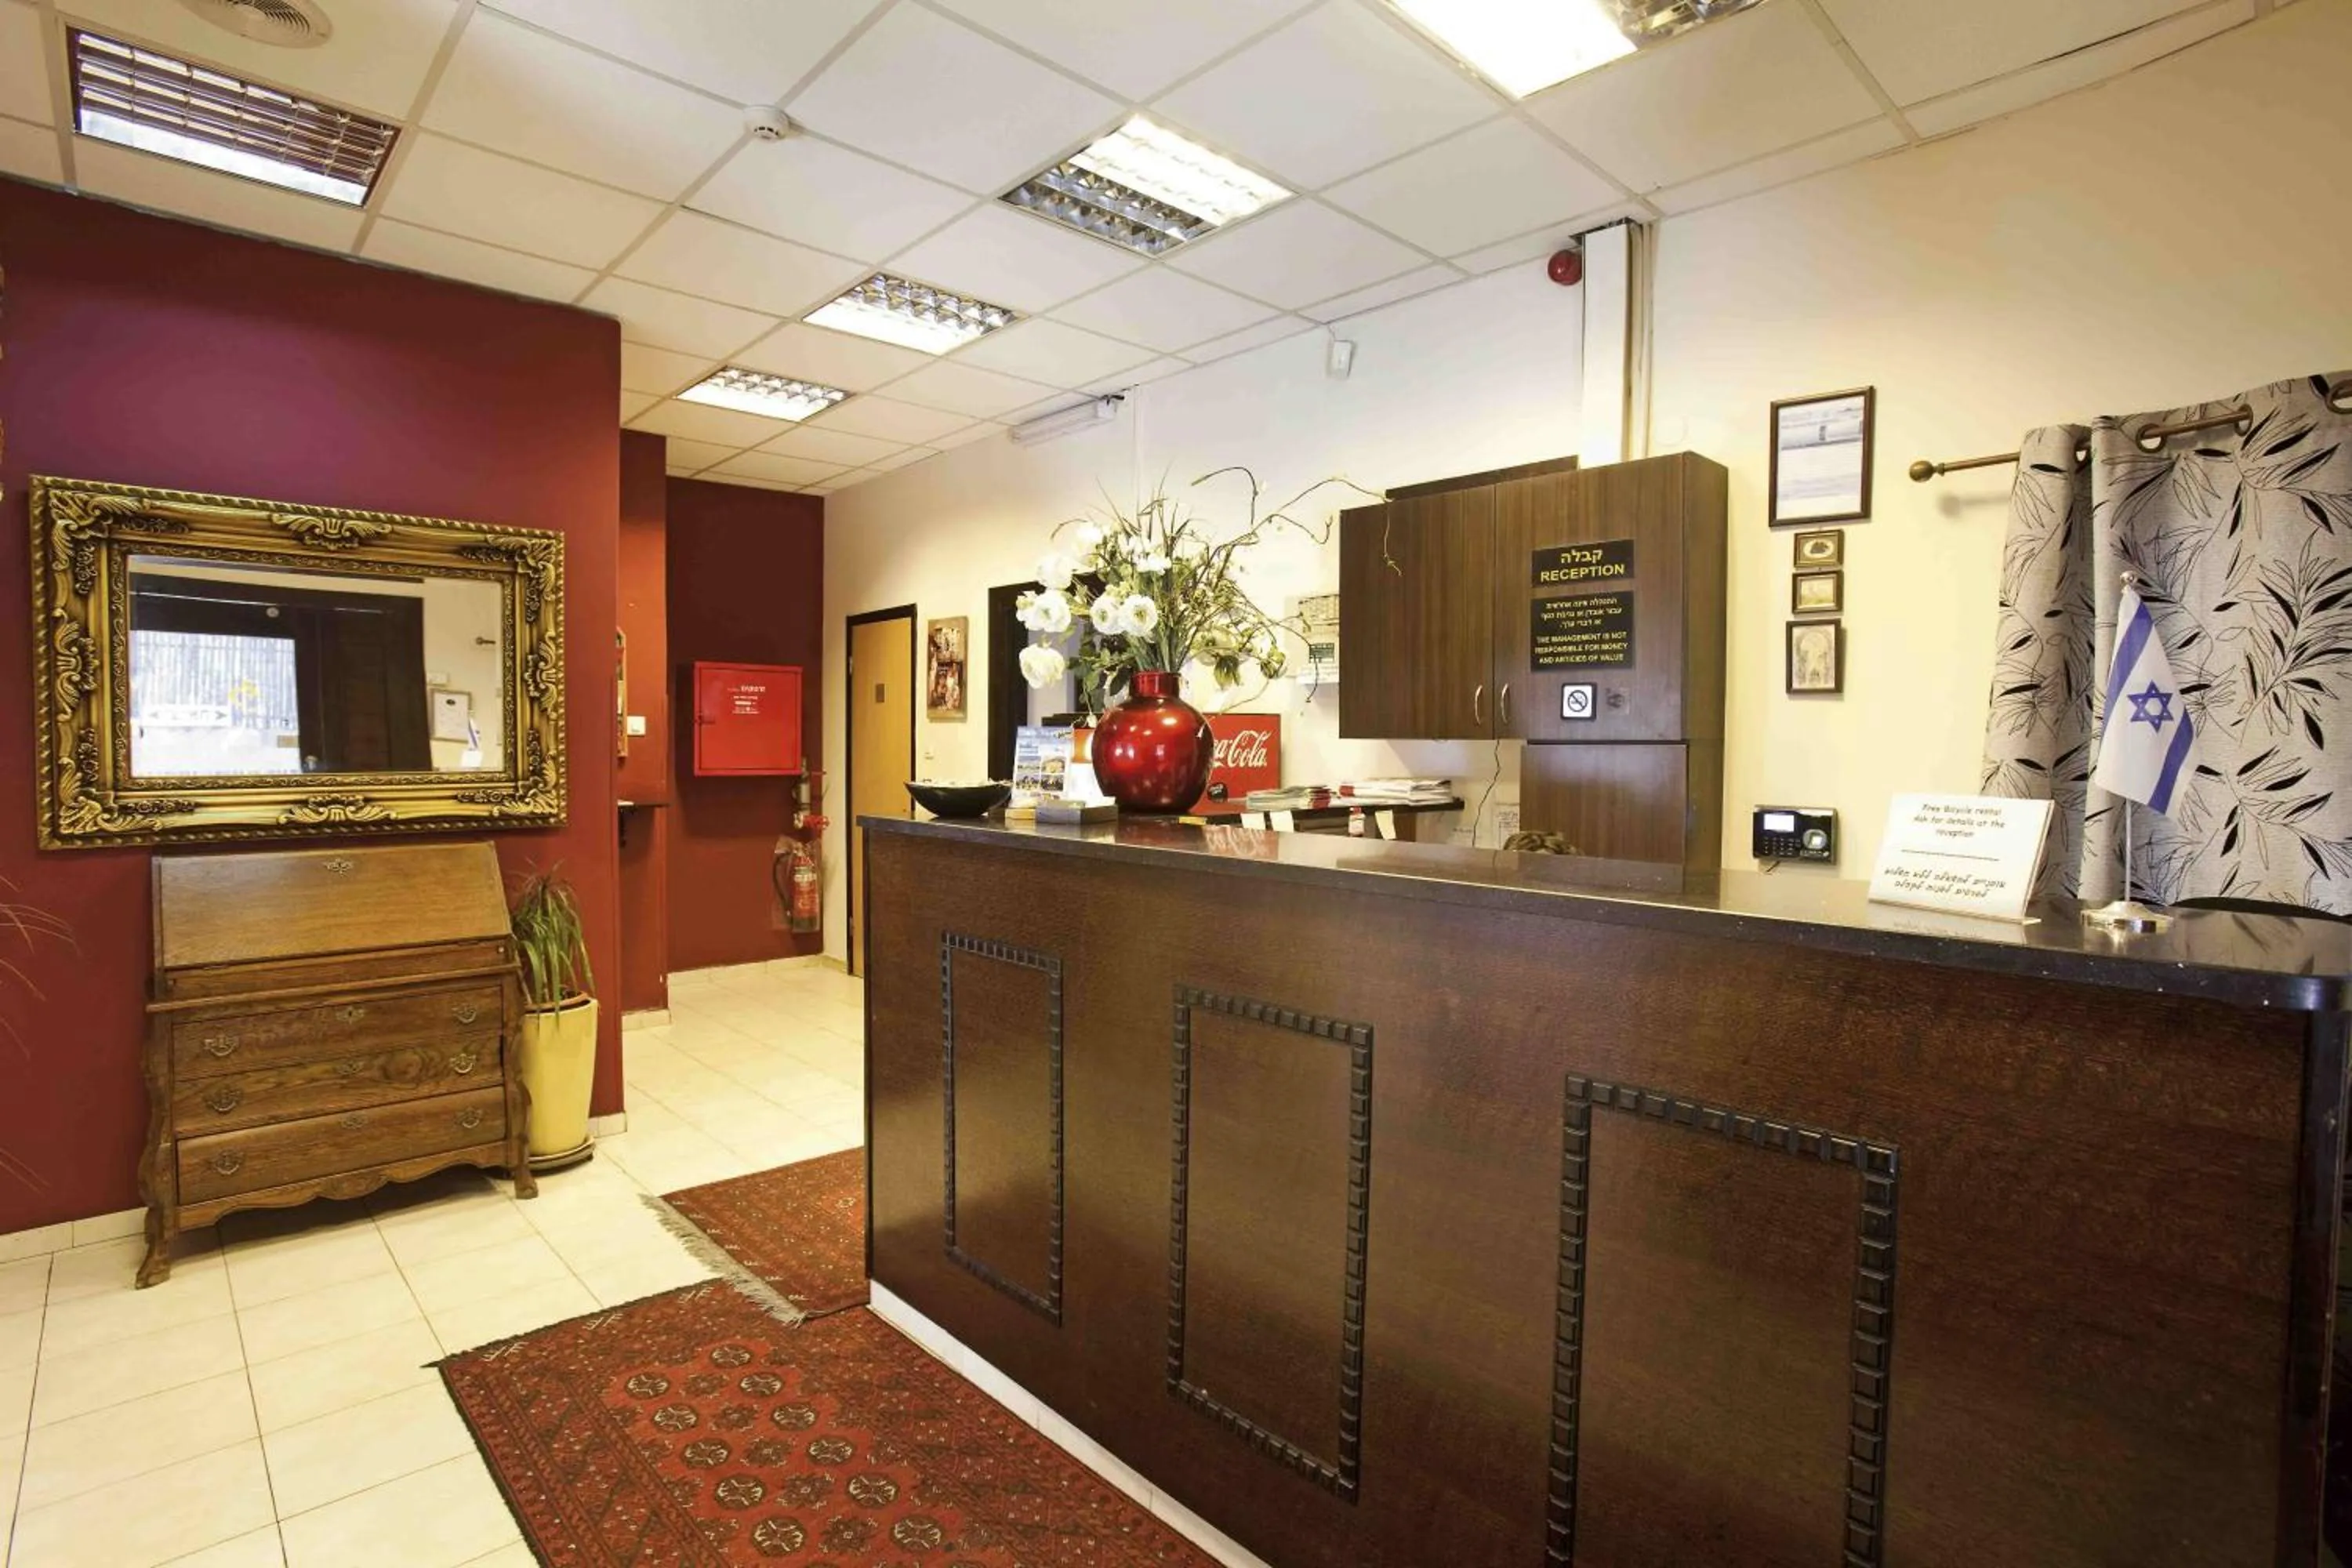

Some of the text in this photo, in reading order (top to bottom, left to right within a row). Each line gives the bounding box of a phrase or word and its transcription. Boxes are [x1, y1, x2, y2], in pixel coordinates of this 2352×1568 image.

[1561, 549, 1603, 564] קבלה
[1541, 564, 1624, 583] RECEPTION
[1551, 633, 1601, 643] MANAGEMENT
[1612, 631, 1627, 640] NOT
[1535, 645, 1583, 654] RESPONSIBLE
[1922, 804, 2002, 816] Free Bicycle rental
[1931, 815, 1943, 824] for
[1991, 818, 2005, 828] the
[1936, 829, 1974, 839] reception
[1884, 866, 1910, 877] תשלום
[1913, 869, 1932, 879] ללא
